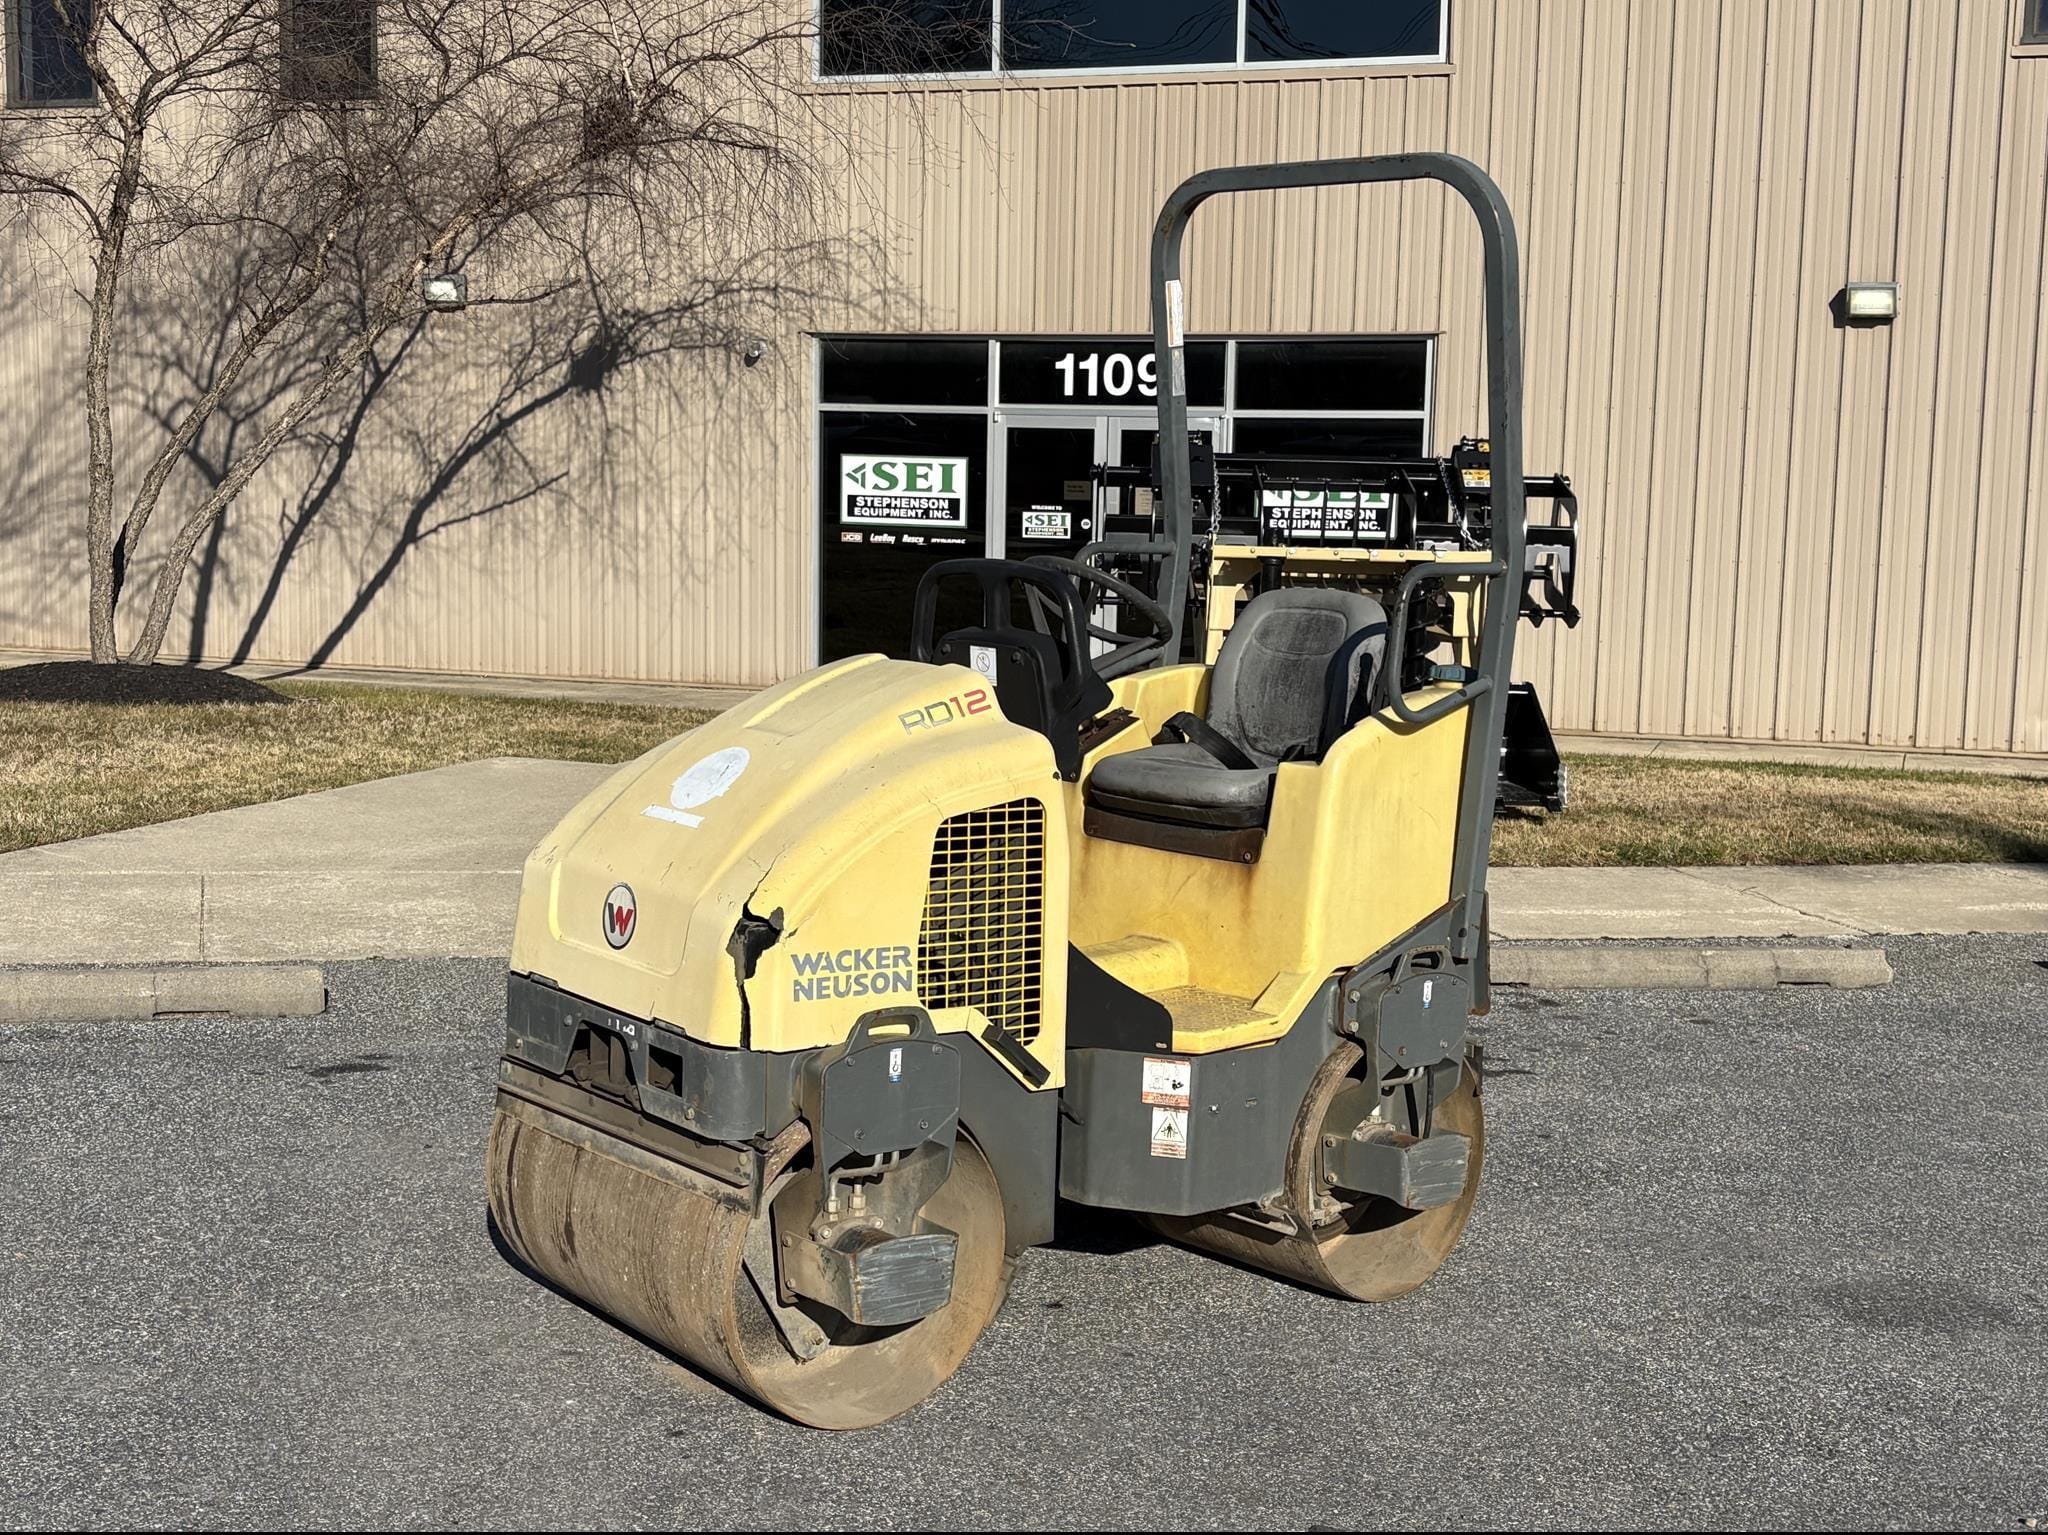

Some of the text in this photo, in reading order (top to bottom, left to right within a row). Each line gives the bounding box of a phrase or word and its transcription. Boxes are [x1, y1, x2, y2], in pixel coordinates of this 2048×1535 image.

[1055, 353, 1157, 396] 1109
[872, 461, 957, 493] SEI
[854, 507, 953, 519] EQUIPMENT, INC.
[856, 496, 949, 510] STEPHENSON
[1034, 514, 1067, 526] SEI
[1359, 520, 1380, 530] NC.
[898, 689, 992, 735] RD12
[791, 946, 912, 976] WACKER
[793, 970, 912, 1002] NEUSON
